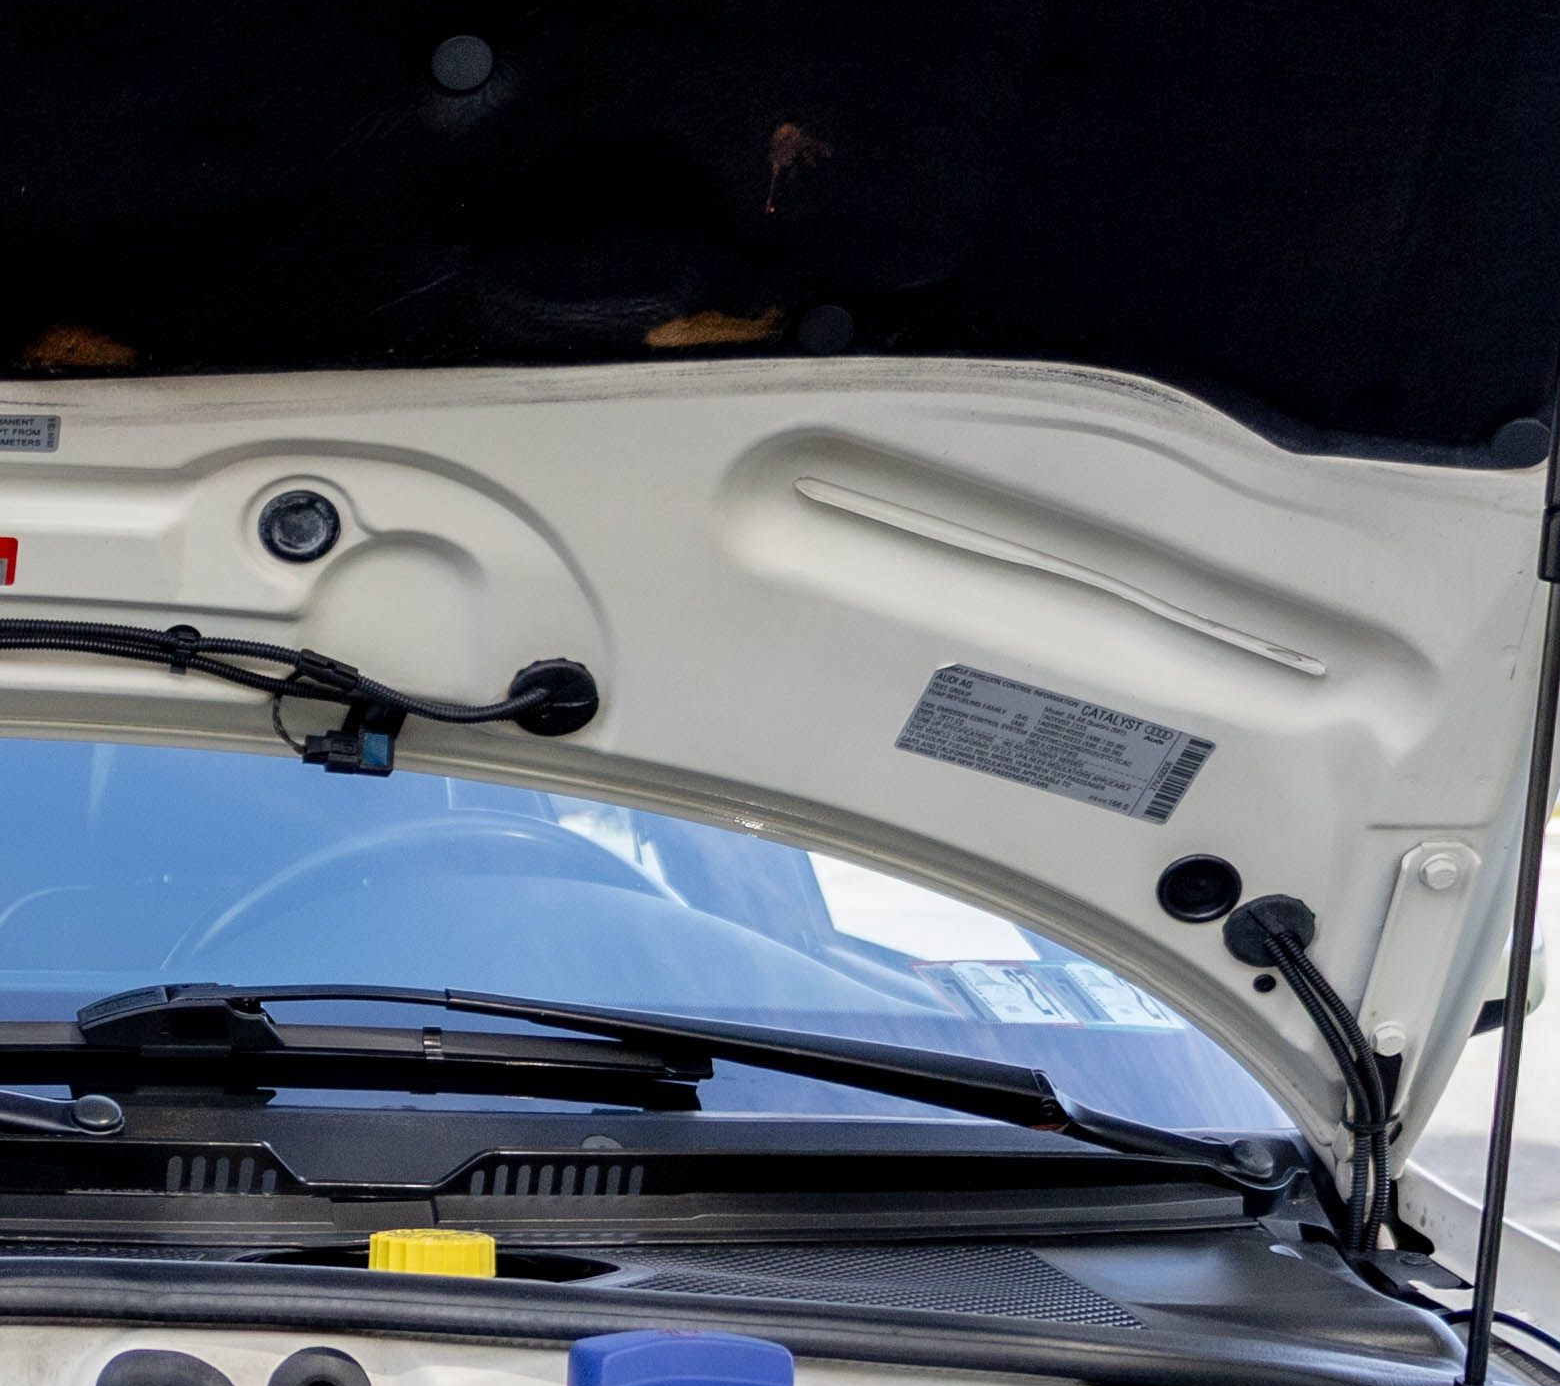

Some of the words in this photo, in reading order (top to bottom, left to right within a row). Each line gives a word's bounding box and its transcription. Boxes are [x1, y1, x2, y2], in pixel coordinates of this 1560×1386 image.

[11, 428, 40, 436] FROM
[934, 671, 959, 685] AUDI
[957, 678, 974, 689] AG
[1078, 704, 1144, 732] CATALYST
